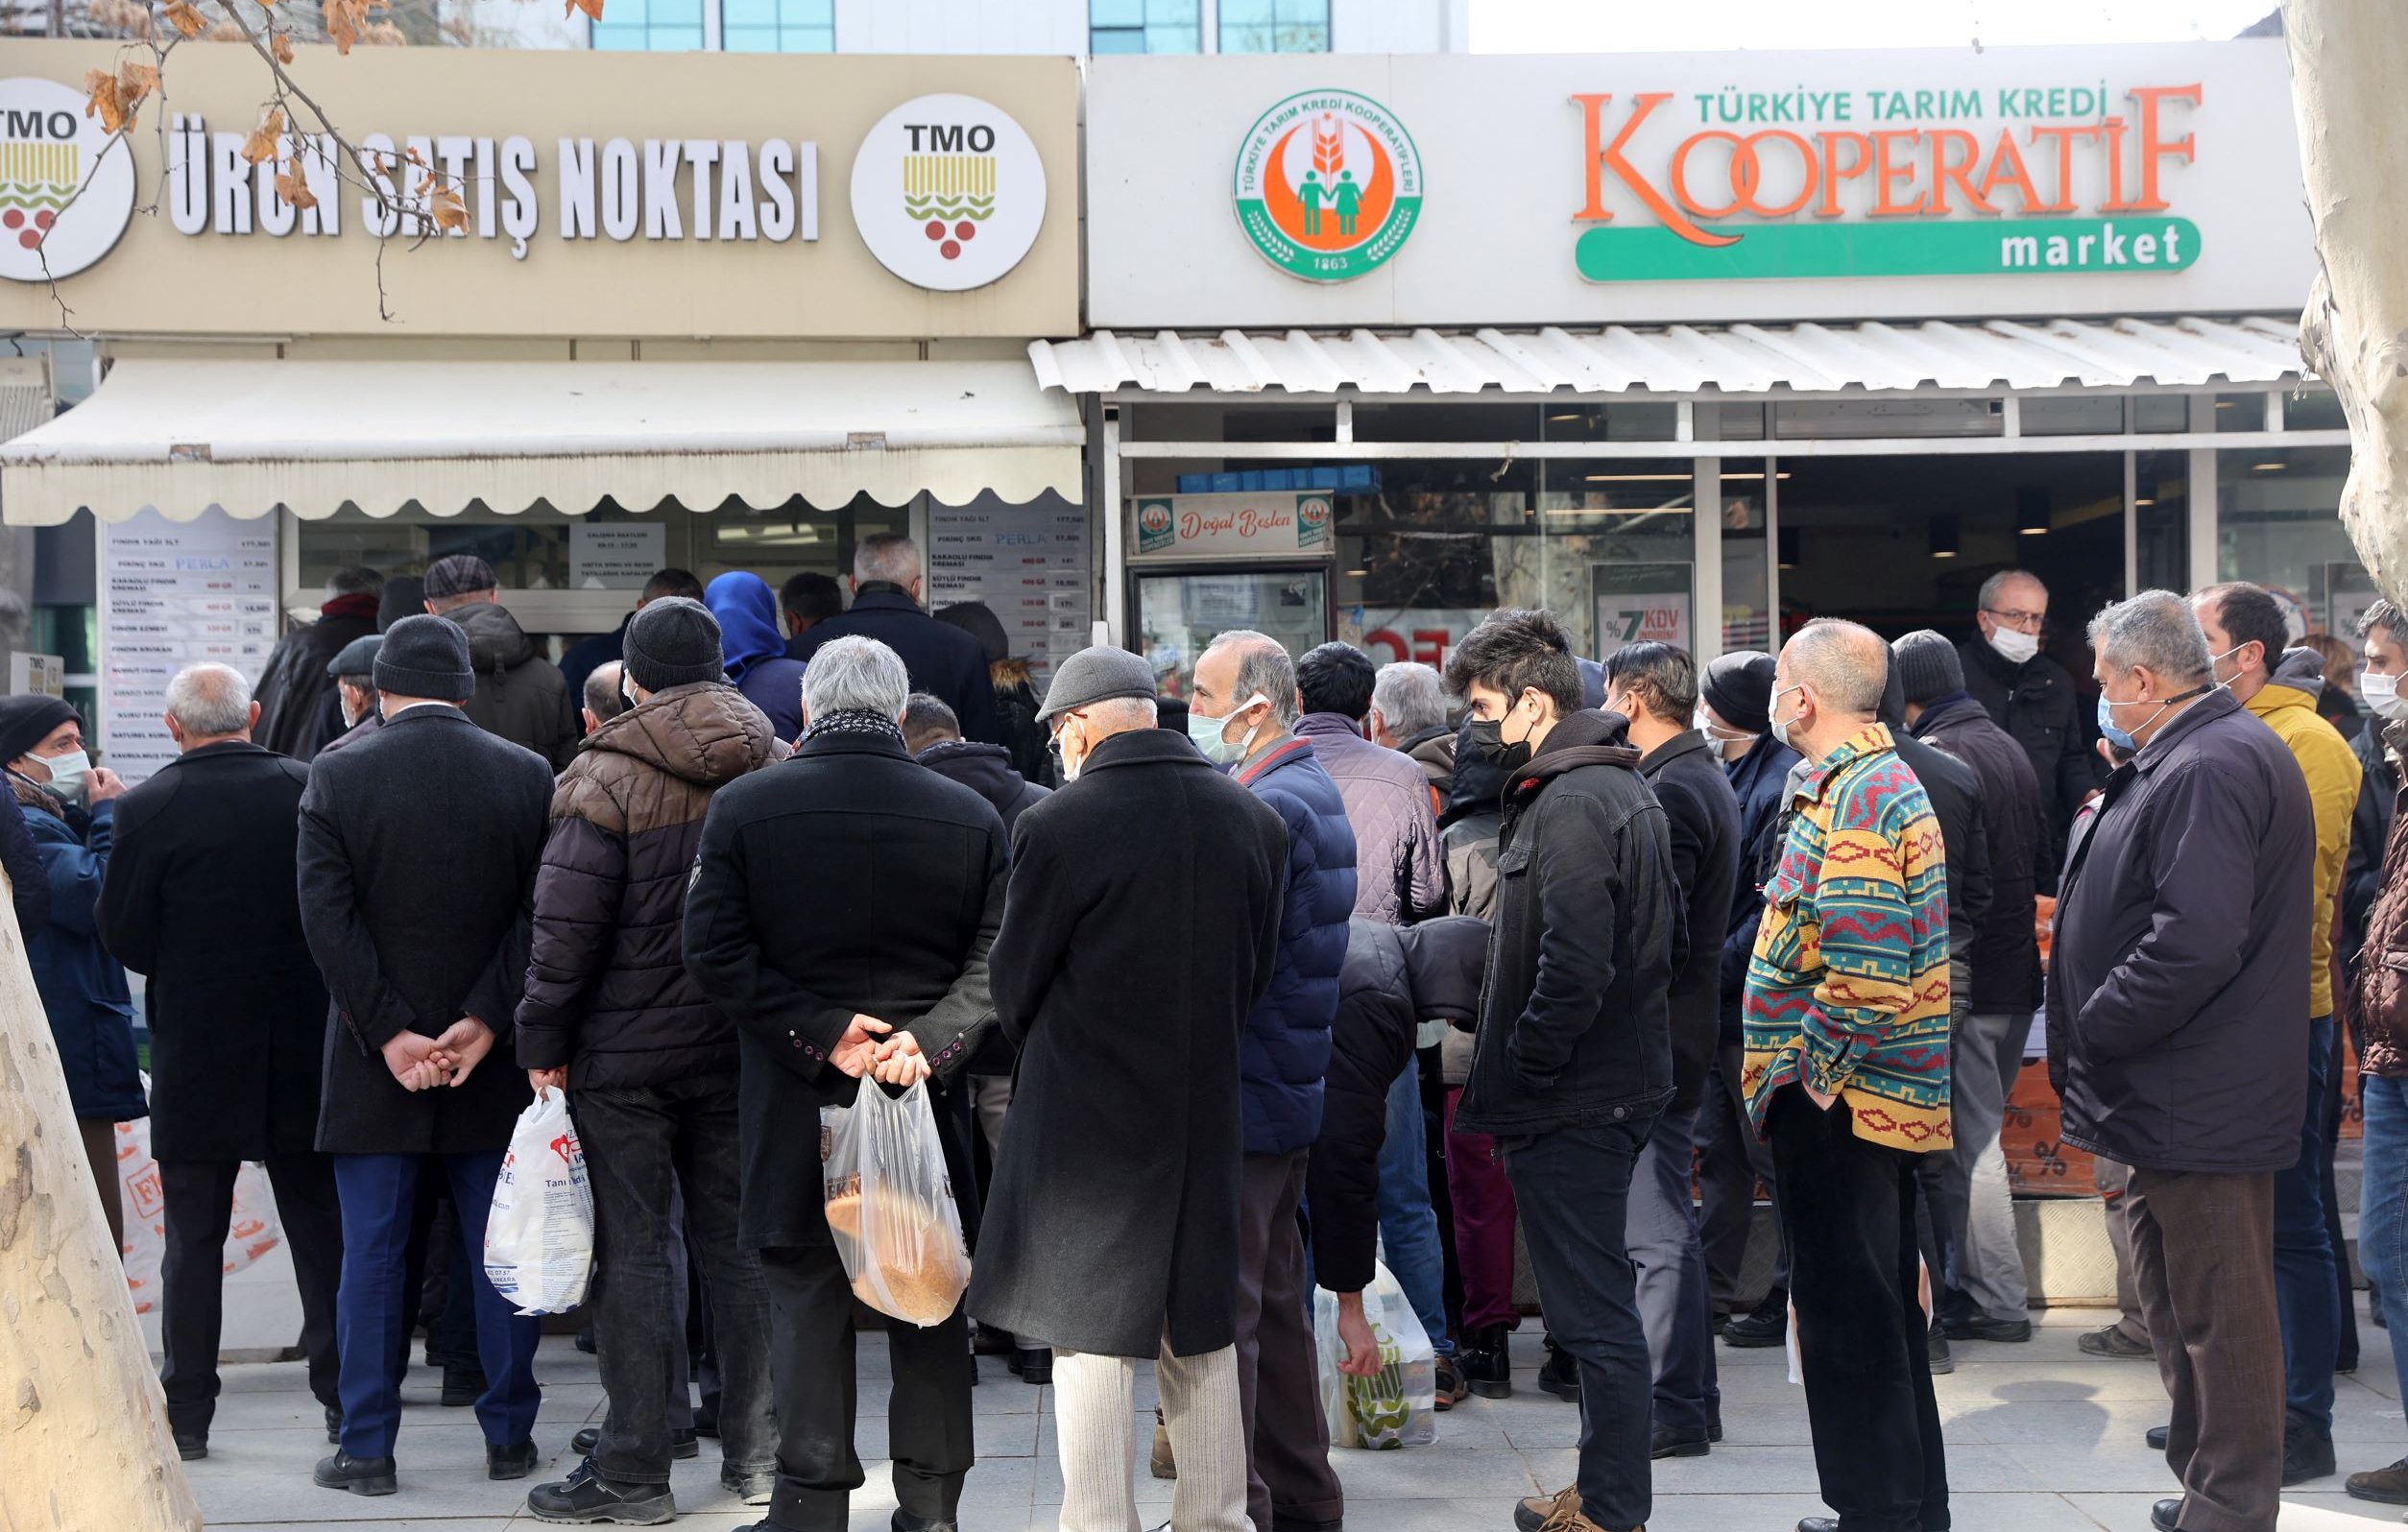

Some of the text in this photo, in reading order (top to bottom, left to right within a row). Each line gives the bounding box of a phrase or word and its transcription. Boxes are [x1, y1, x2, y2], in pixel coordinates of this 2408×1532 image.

[1695, 80, 2107, 123] TÜRKİYE TARIM KREDİ
[0, 109, 78, 140] MO
[903, 124, 996, 153] TMO
[1243, 98, 1415, 193] TÜRKİYE TARIM KREDİ KOOPERATİFLERİ
[1569, 83, 2203, 248] KOOPERATİF
[169, 111, 819, 260] ÜRÜN SATIŞ NOKTASI
[1313, 256, 1348, 270] 1863
[2001, 224, 2180, 267] market
[1180, 511, 1235, 539] Doğal
[1645, 609, 1679, 629] KDV
